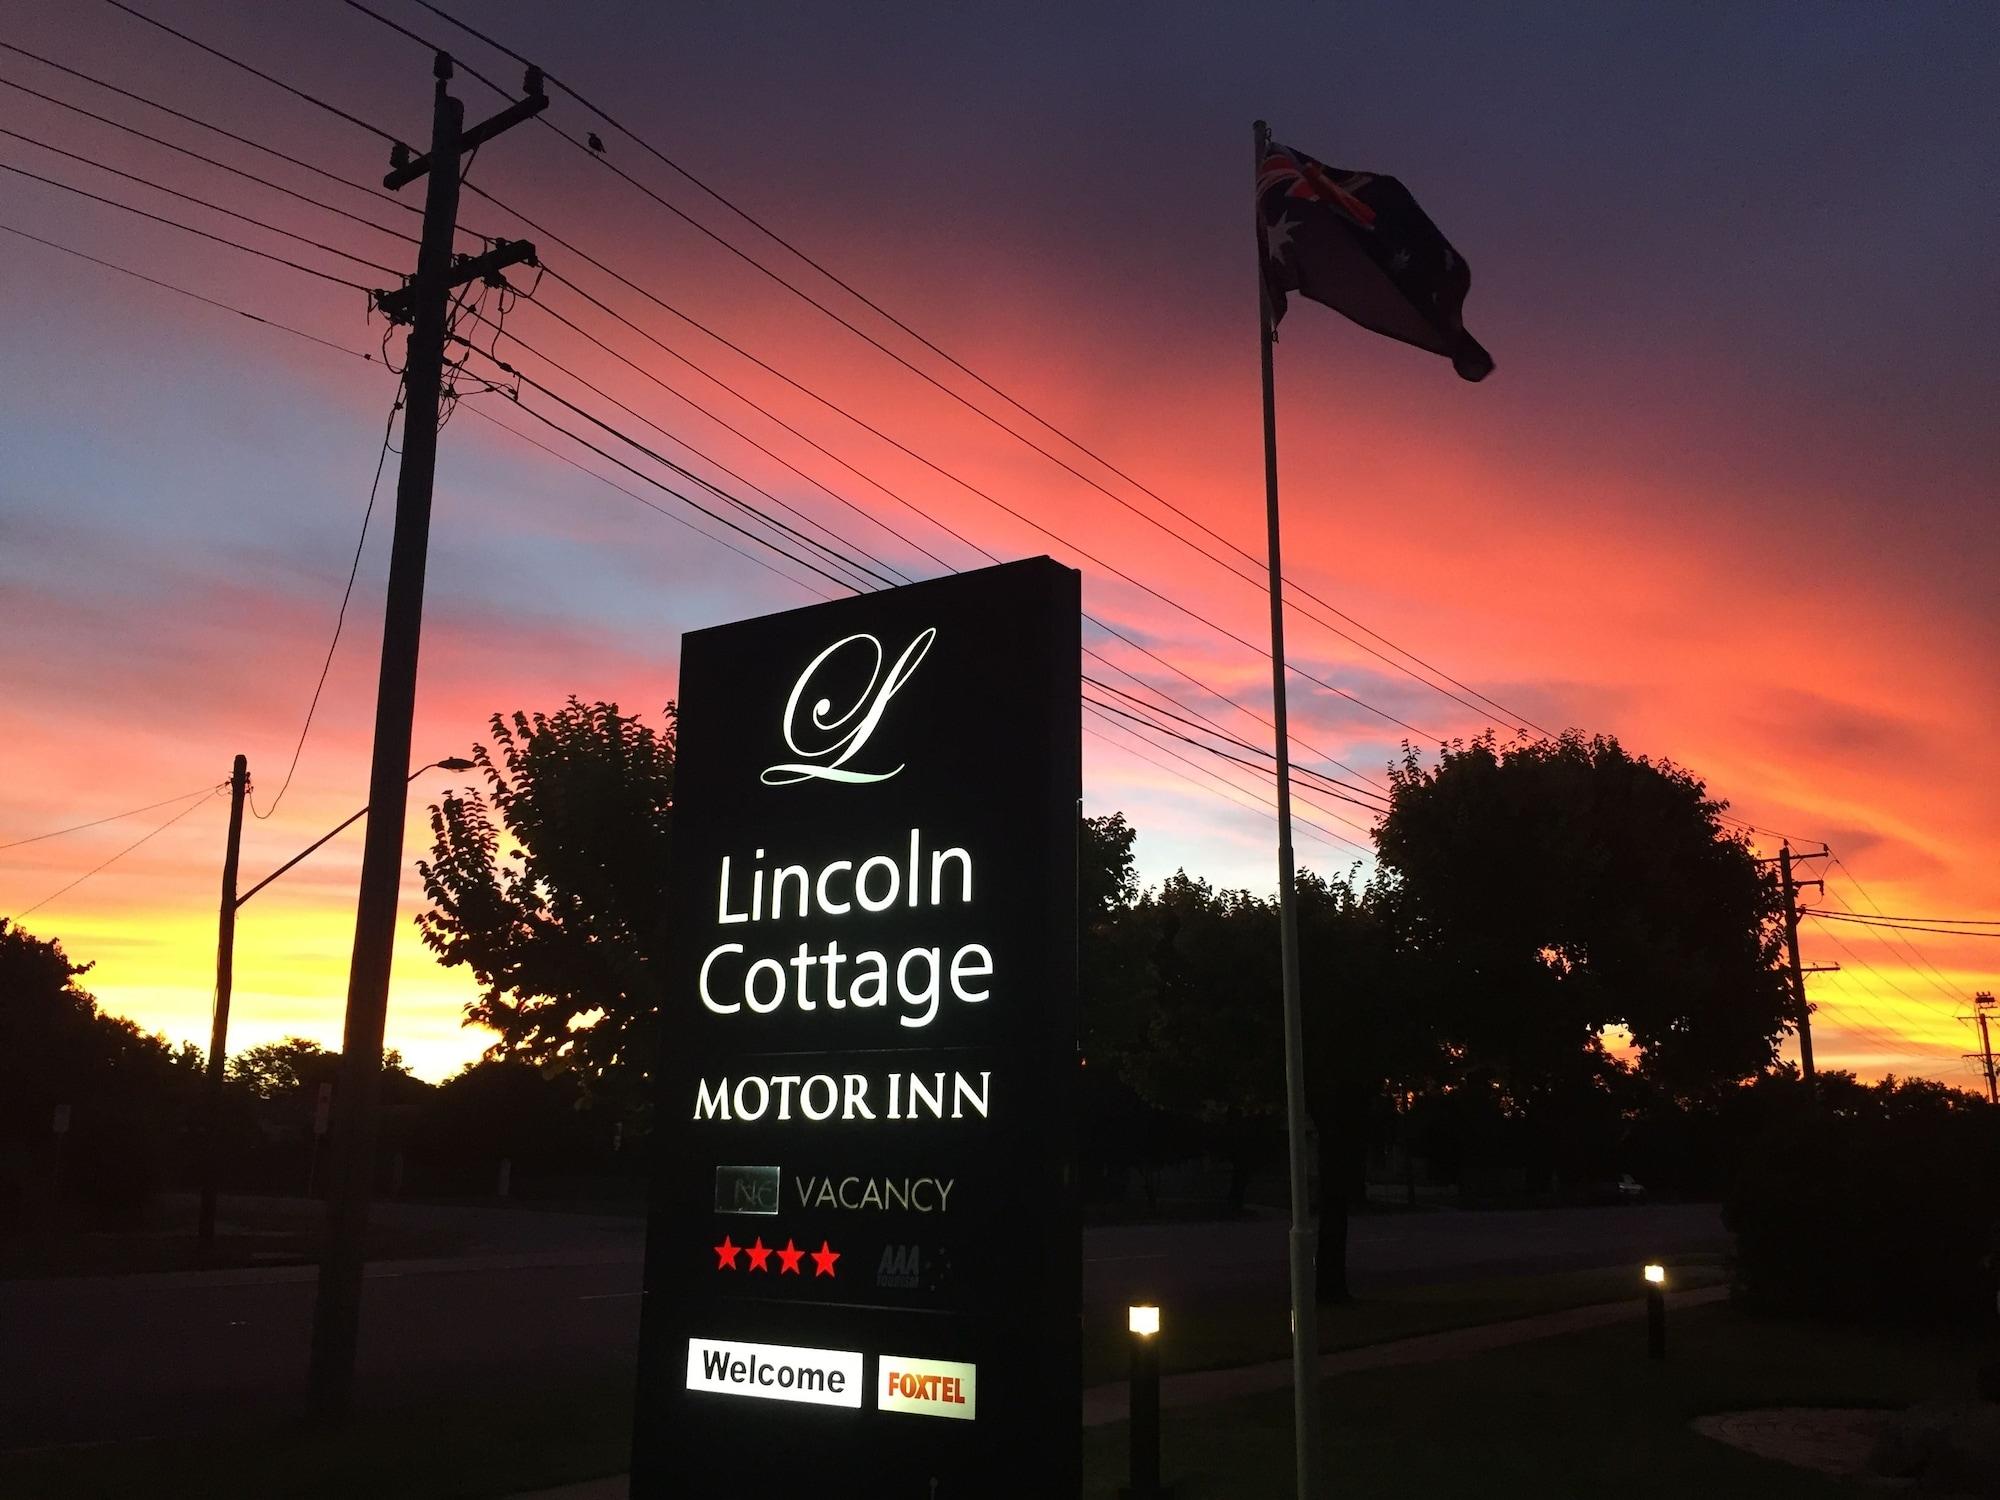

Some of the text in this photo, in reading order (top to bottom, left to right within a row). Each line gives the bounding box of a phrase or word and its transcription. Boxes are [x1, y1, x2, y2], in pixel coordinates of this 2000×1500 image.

[718, 827, 972, 924] Lincoln
[699, 940, 994, 1028] Cottage
[693, 1071, 992, 1121] MOTOR INN
[796, 1176, 955, 1212] VACANCY
[877, 1243, 919, 1274] AAA
[703, 1350, 846, 1393] Welcome
[889, 1371, 965, 1404] FOXTEL
